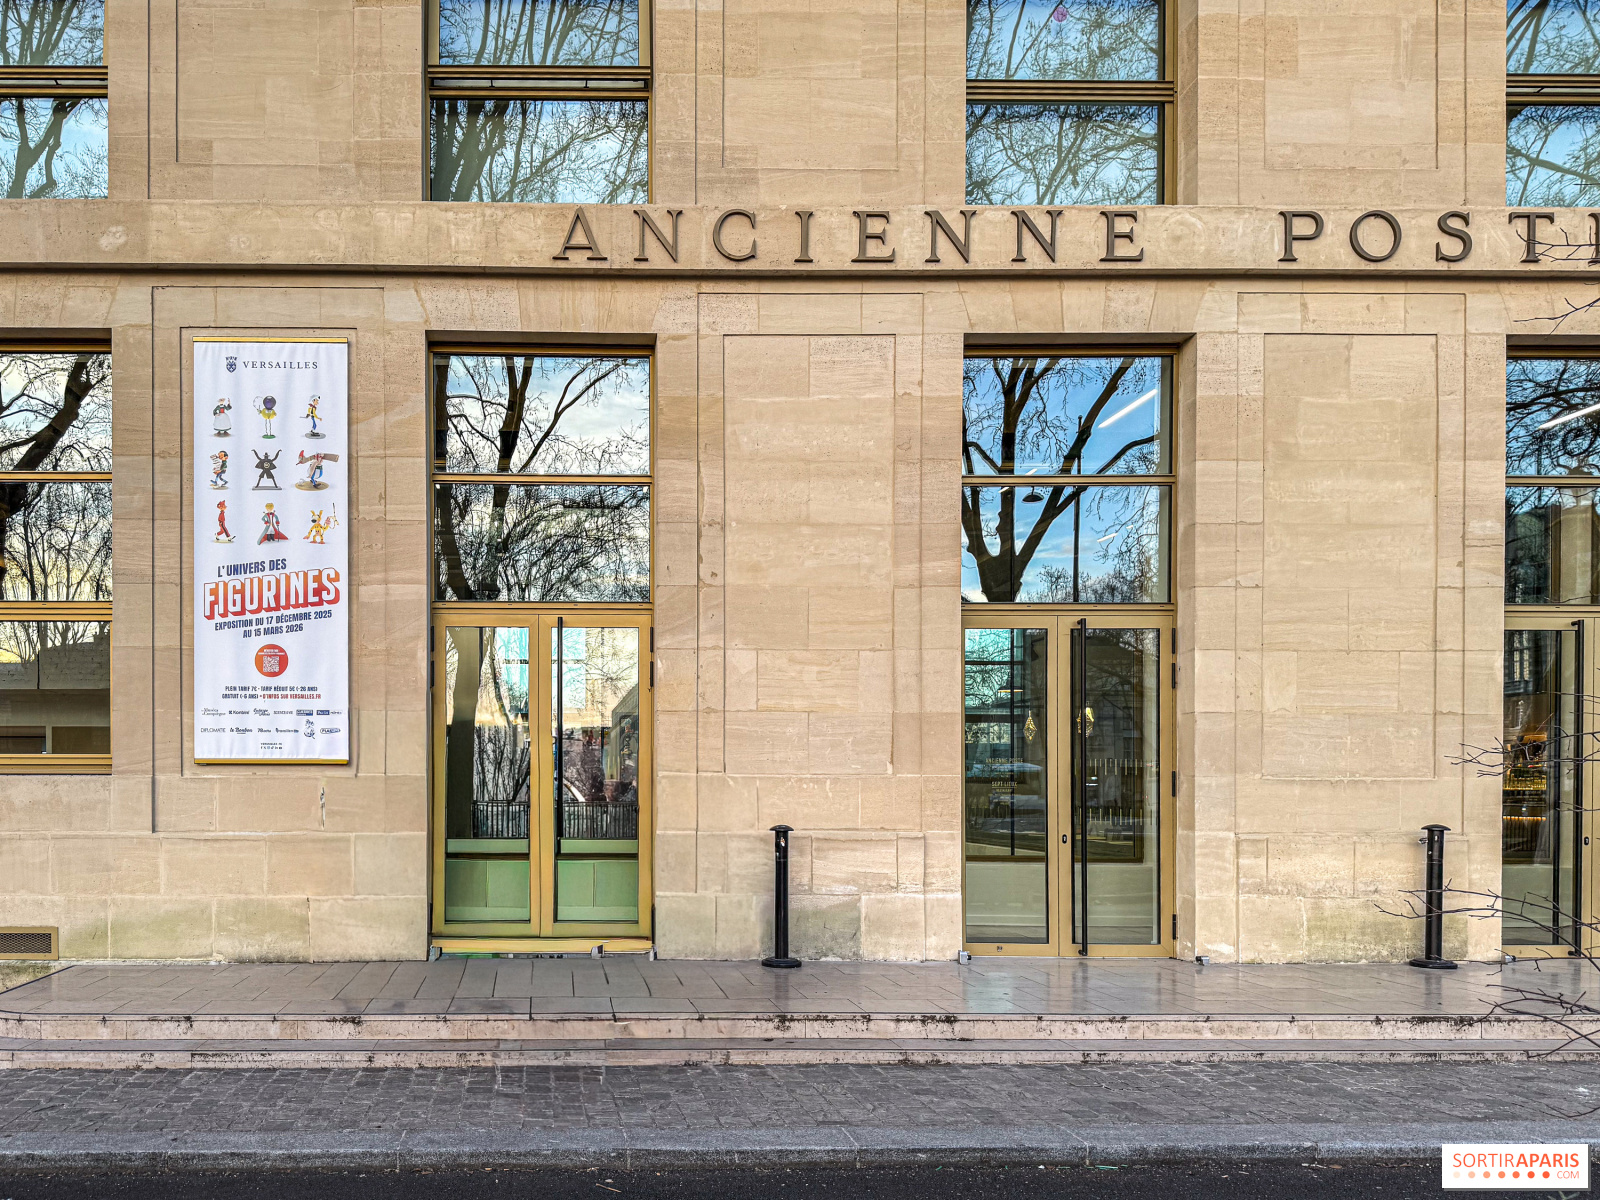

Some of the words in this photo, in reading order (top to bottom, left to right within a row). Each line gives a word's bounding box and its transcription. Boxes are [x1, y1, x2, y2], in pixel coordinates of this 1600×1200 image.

[552, 206, 1144, 262] ANCIENNE
[1278, 209, 1600, 263] POST
[243, 361, 318, 369] VERSAILLES
[218, 561, 266, 577] L'UNIVERS
[269, 558, 287, 571] DES
[204, 567, 340, 620] FIGURINES
[215, 618, 253, 631] EXPOSITION
[255, 617, 264, 626] DU
[266, 616, 274, 625] 17
[276, 611, 312, 623] DÉCEMBRE
[314, 609, 332, 619] 2025
[243, 629, 252, 638] AU
[254, 628, 262, 637] 15
[264, 625, 283, 636] MARS
[285, 623, 304, 633] 2026
